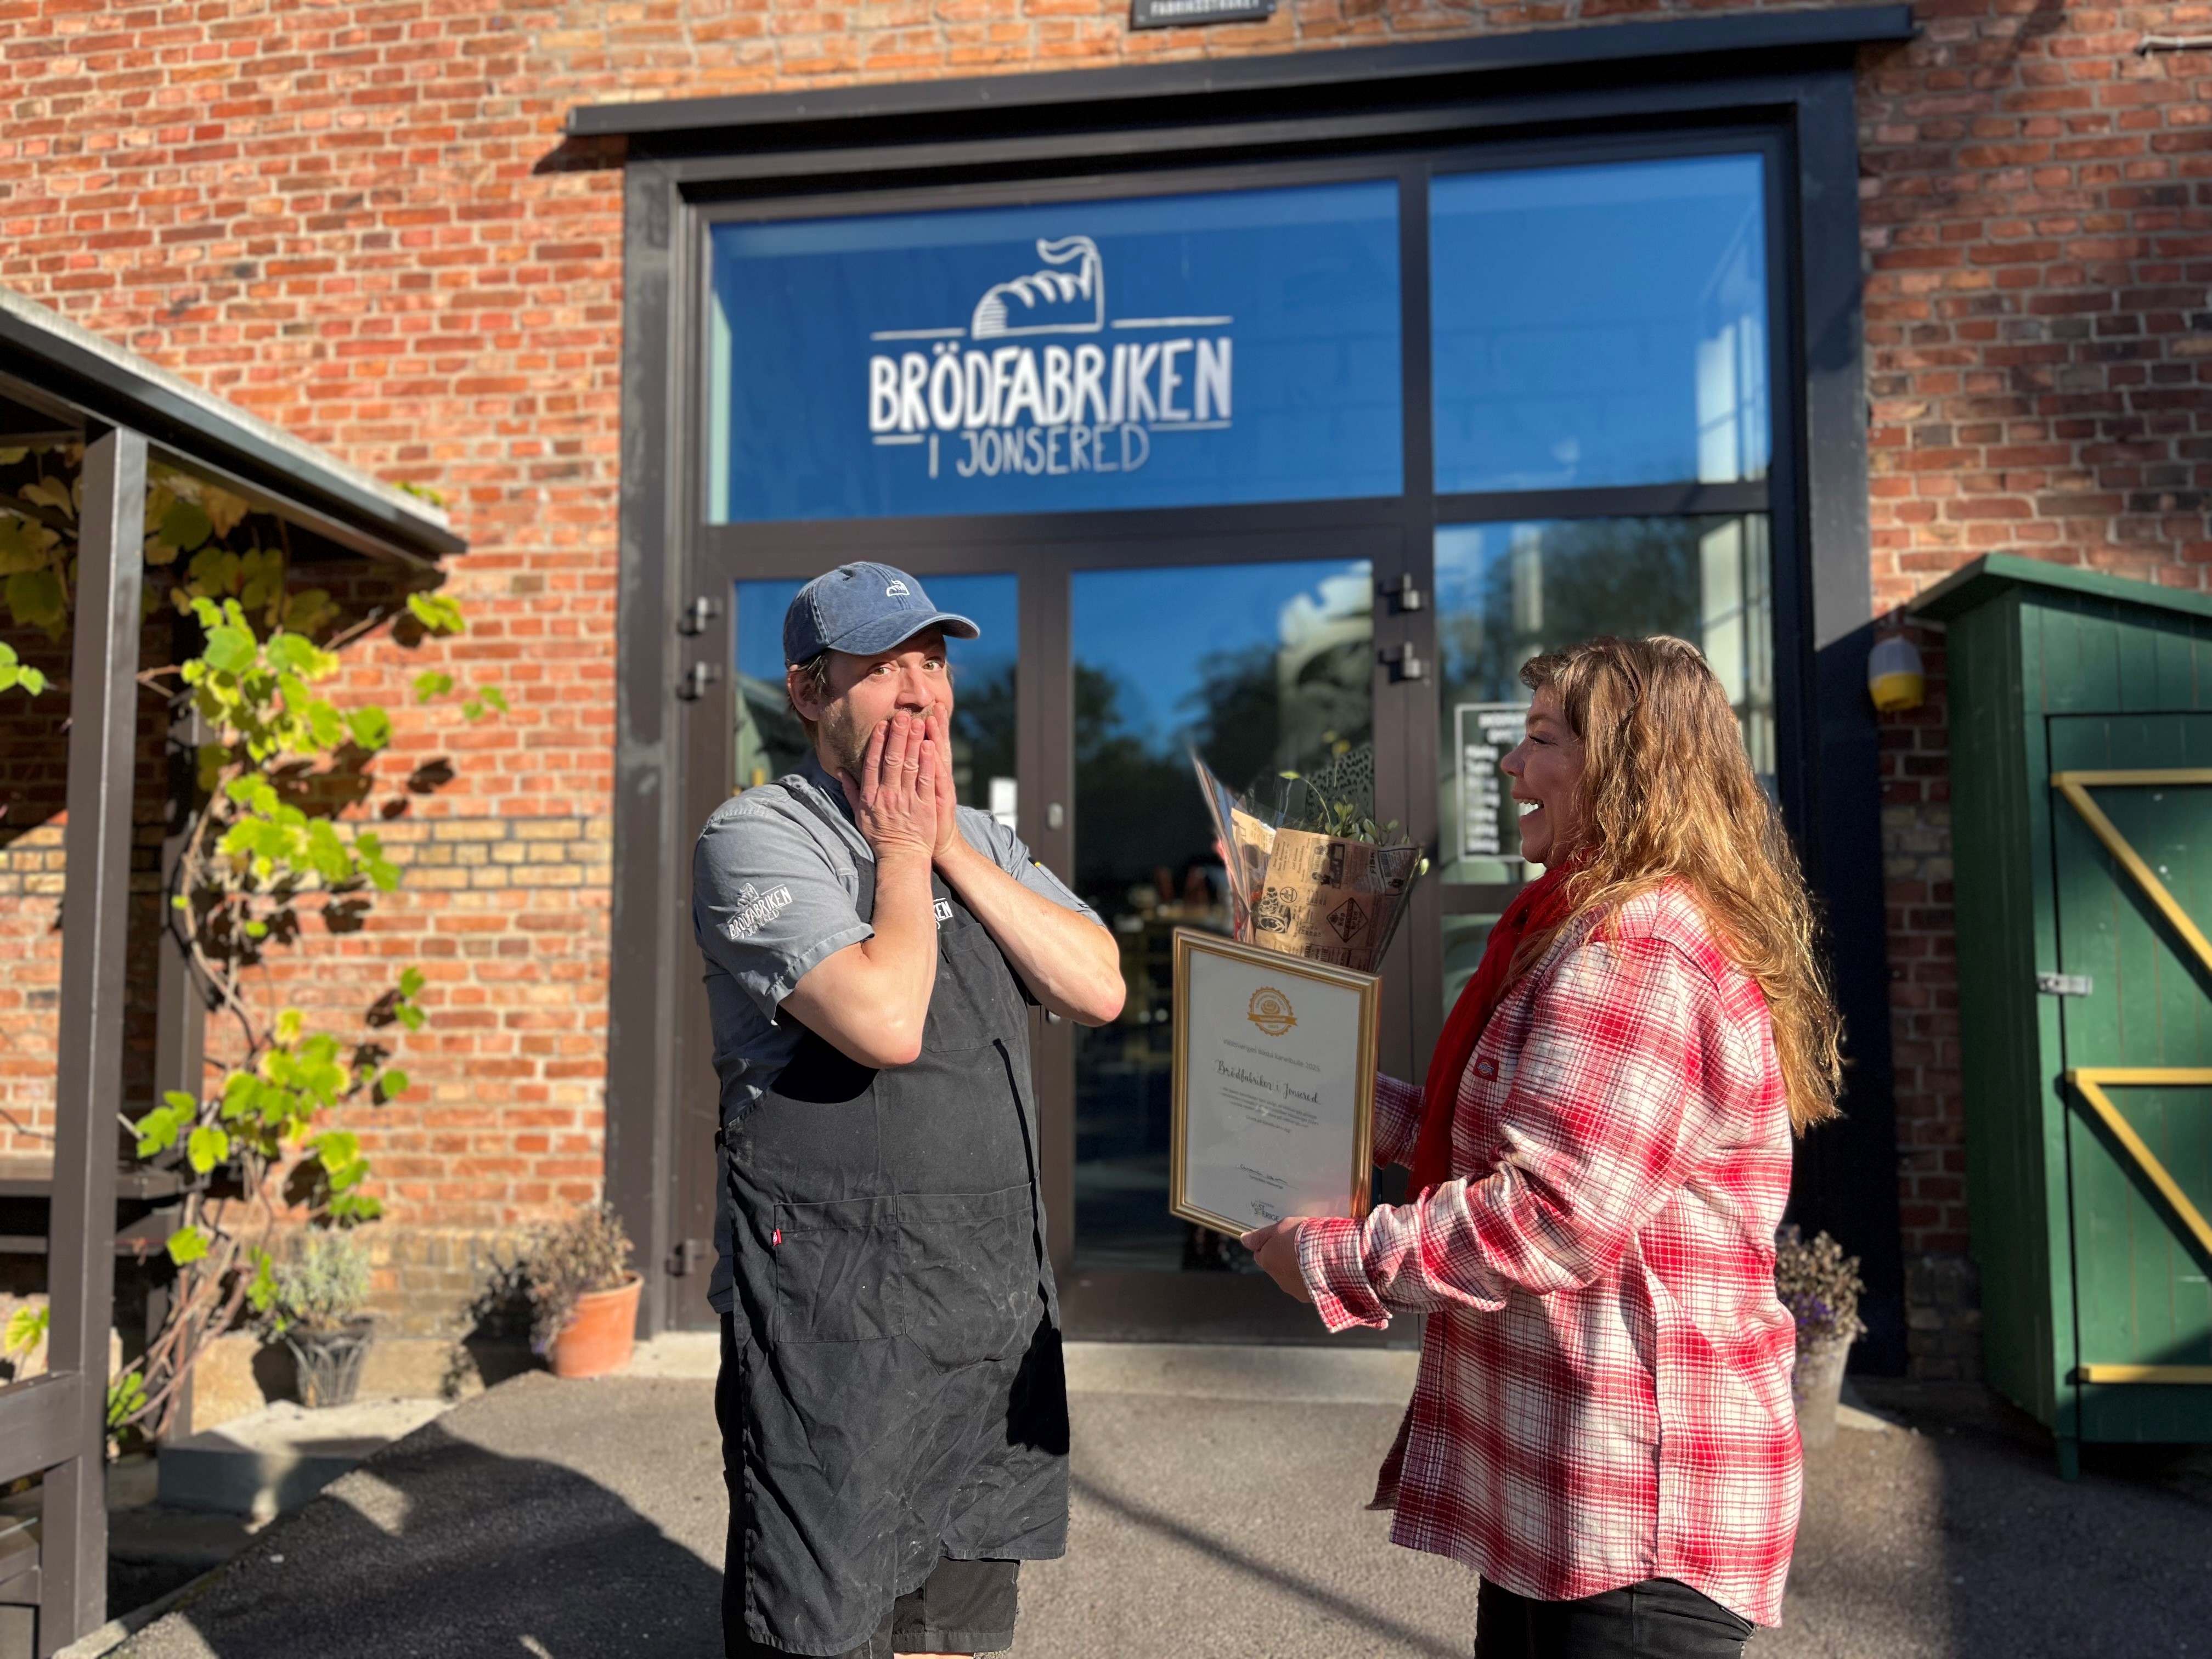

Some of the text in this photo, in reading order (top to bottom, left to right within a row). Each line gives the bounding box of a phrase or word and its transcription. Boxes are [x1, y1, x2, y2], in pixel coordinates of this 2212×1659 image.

[869, 337, 1233, 433] BRÖDFABRIKEN
[929, 422, 1150, 479] I JONSERED
[1214, 1059, 1273, 1091] Brödfabriken
[1283, 1082, 1319, 1103] Jonsered
[1305, 1062, 1321, 1072] 2025
